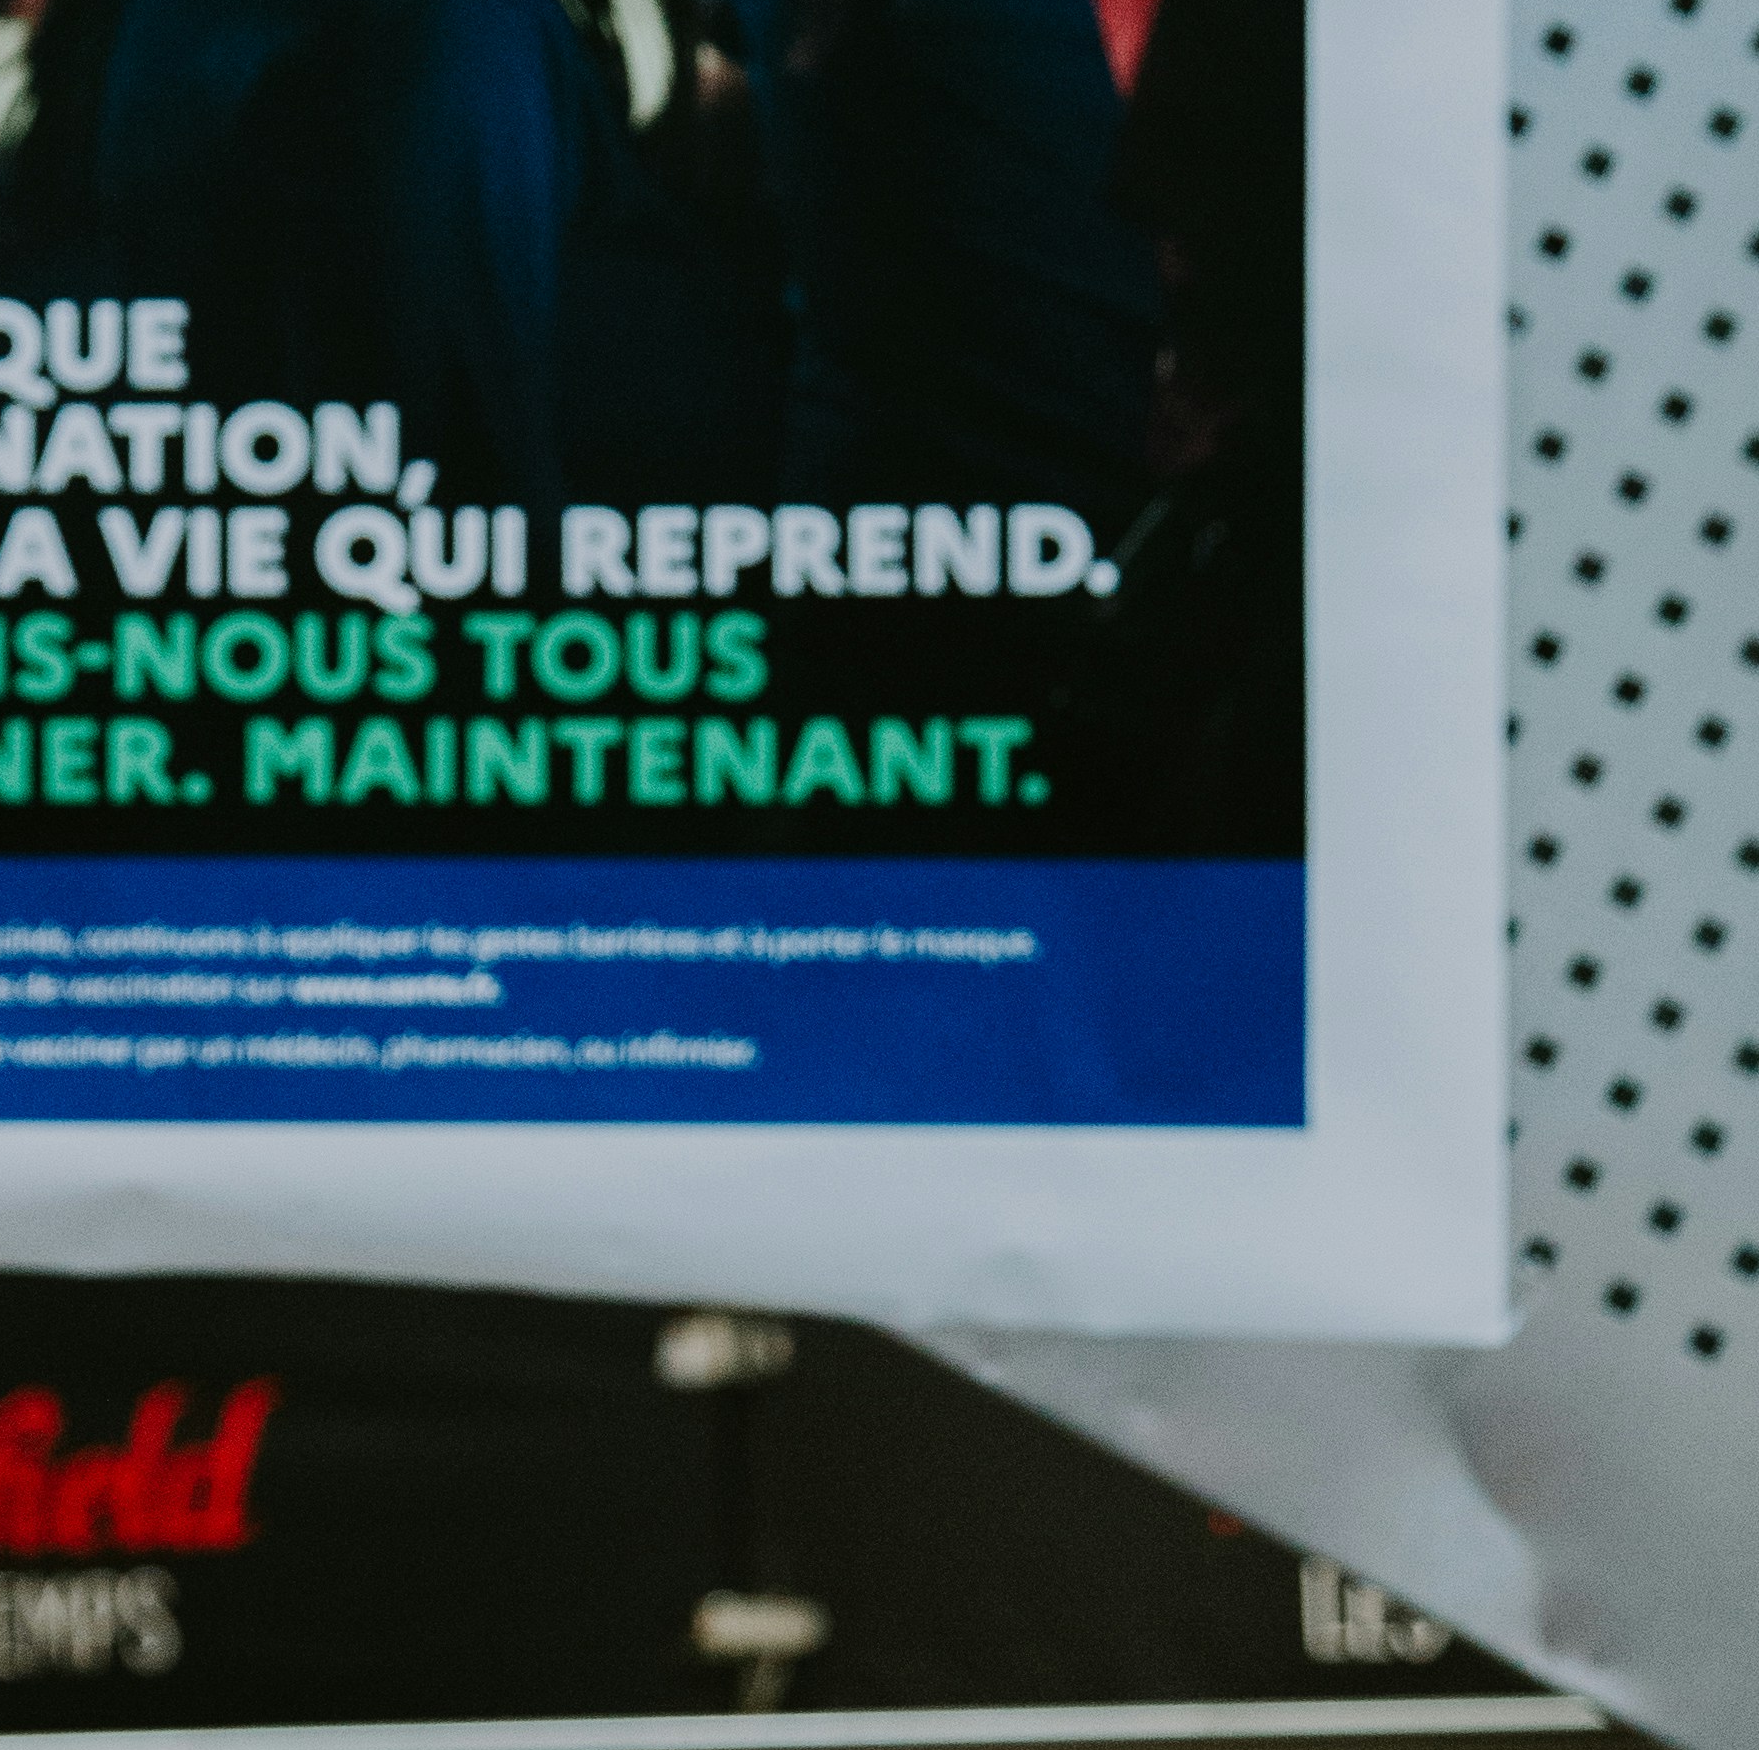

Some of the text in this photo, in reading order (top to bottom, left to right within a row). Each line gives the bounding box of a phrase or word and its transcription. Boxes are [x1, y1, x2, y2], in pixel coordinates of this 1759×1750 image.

[99, 507, 288, 598] VIE
[314, 504, 527, 613] QUI
[561, 504, 1121, 597] REPREND.
[463, 611, 769, 701] TOUS
[244, 716, 1050, 805] MAINTENANT.
